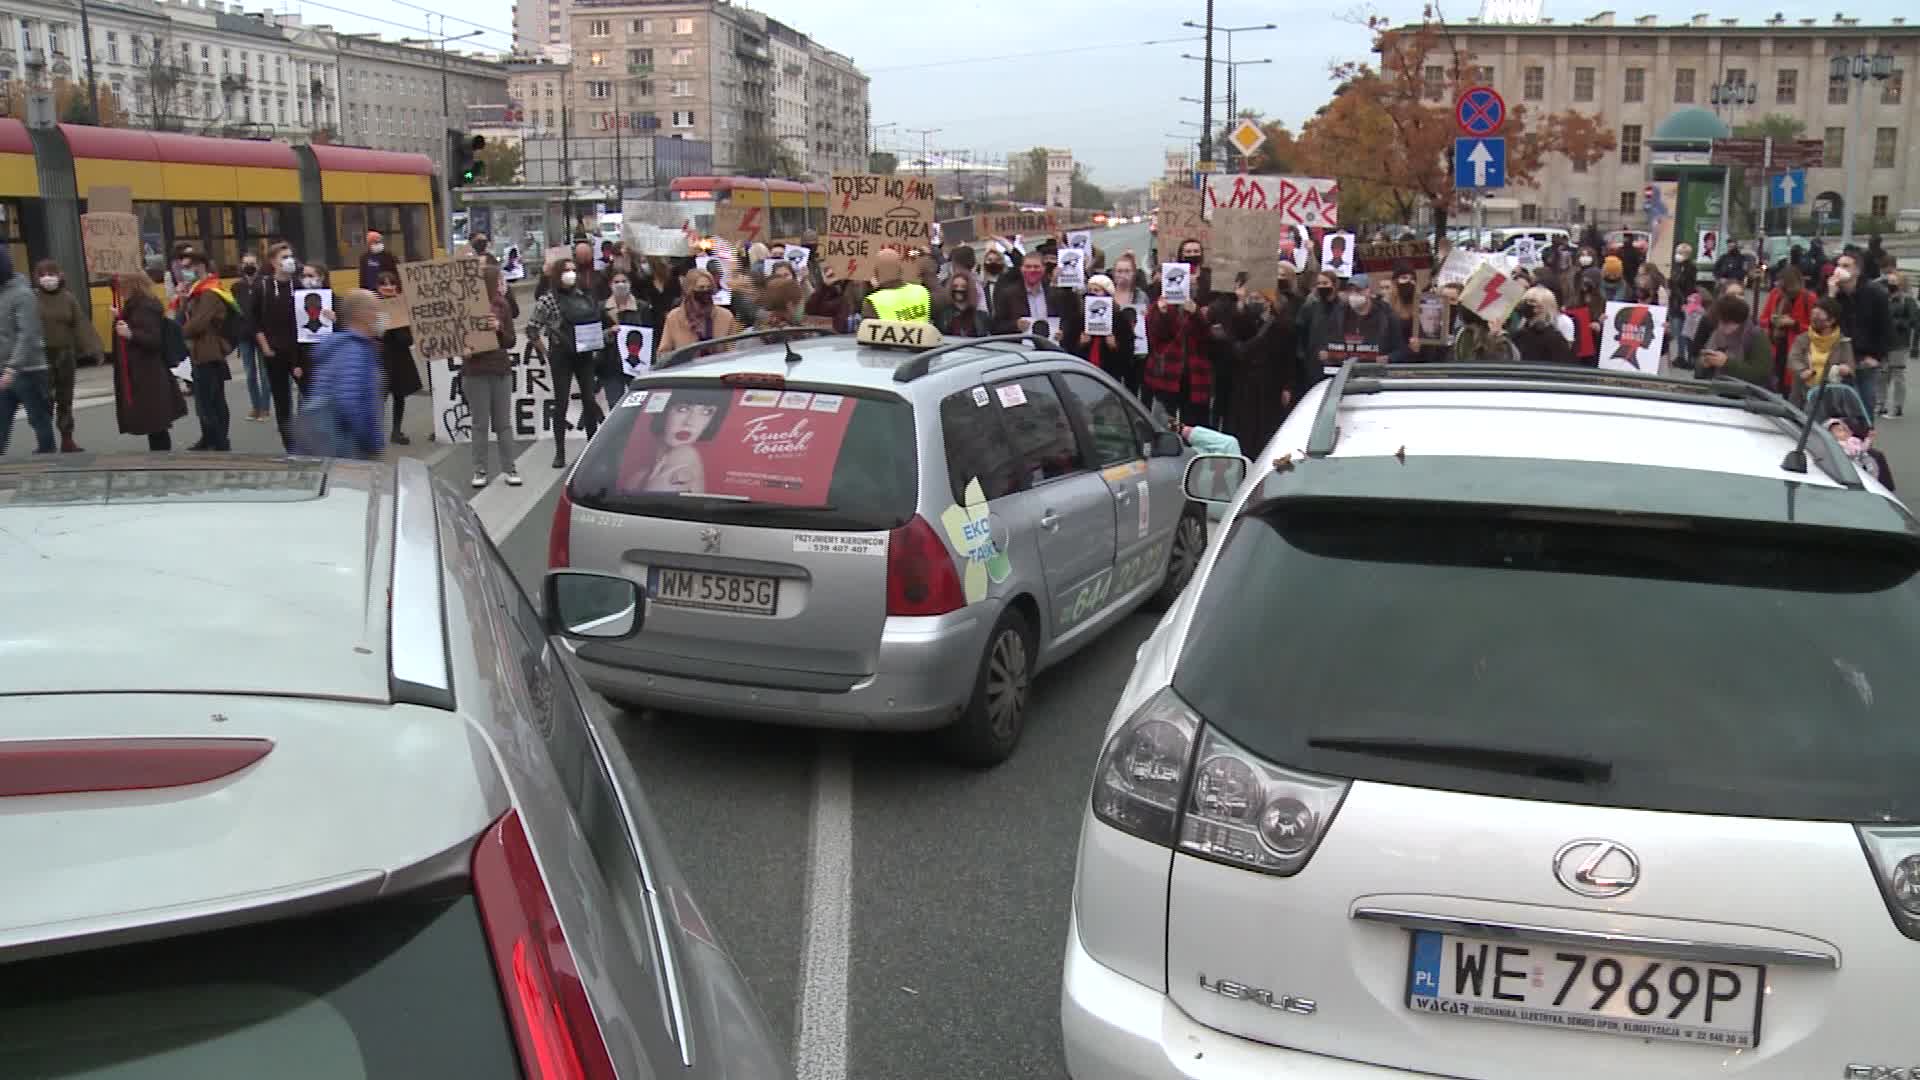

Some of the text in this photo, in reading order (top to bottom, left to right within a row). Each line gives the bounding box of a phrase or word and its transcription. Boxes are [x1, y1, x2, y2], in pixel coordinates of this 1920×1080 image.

[867, 324, 924, 345] TAXI
[662, 571, 771, 605] WM 5585G
[1415, 970, 1436, 988] PL
[1456, 942, 1742, 1024] WE 7969P
[1199, 974, 1317, 1014] LEXUS
[1416, 997, 1470, 1014] WACAR
